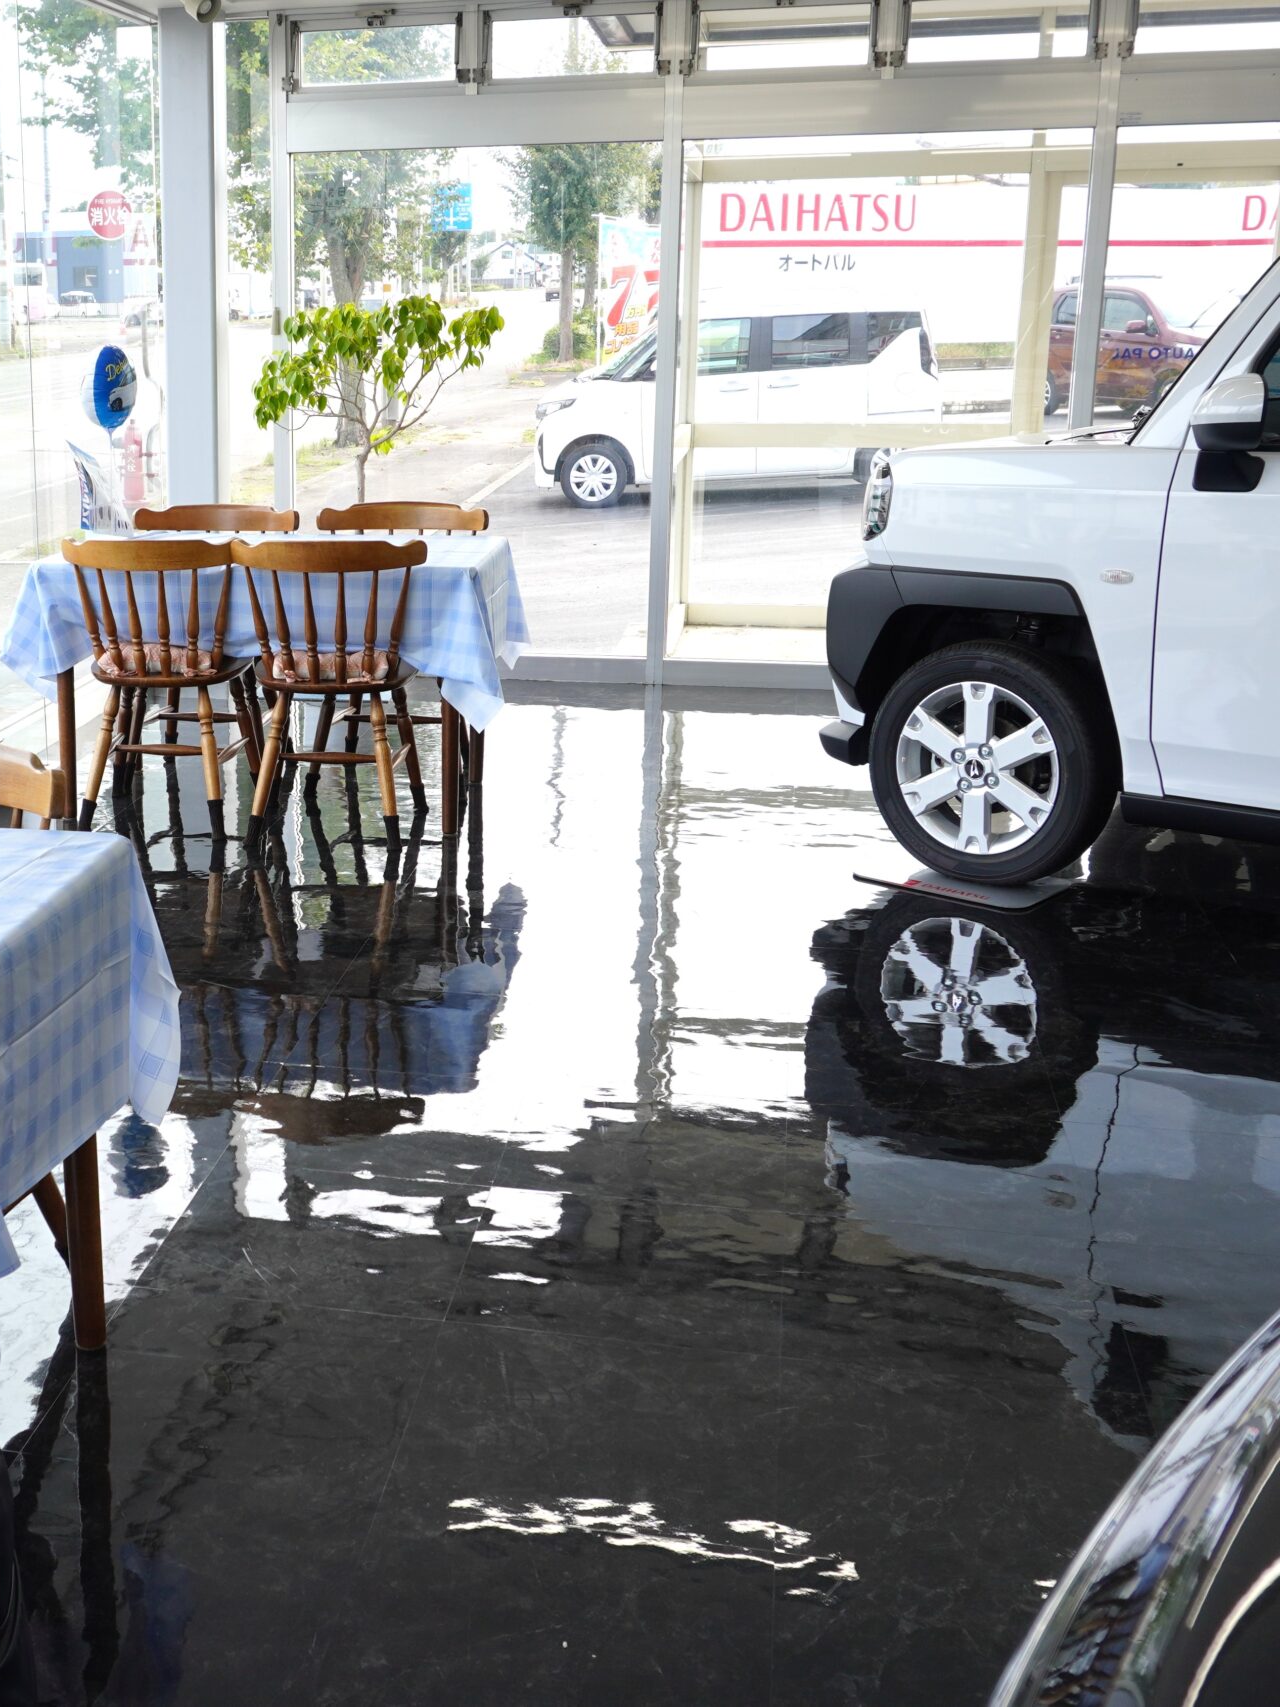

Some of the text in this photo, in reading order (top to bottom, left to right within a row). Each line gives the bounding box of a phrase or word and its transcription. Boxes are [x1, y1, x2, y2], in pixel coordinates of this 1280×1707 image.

[90, 206, 130, 226] 消火栓
[720, 193, 916, 232] DAIHATSU
[921, 884, 991, 900] DAIHATSU
